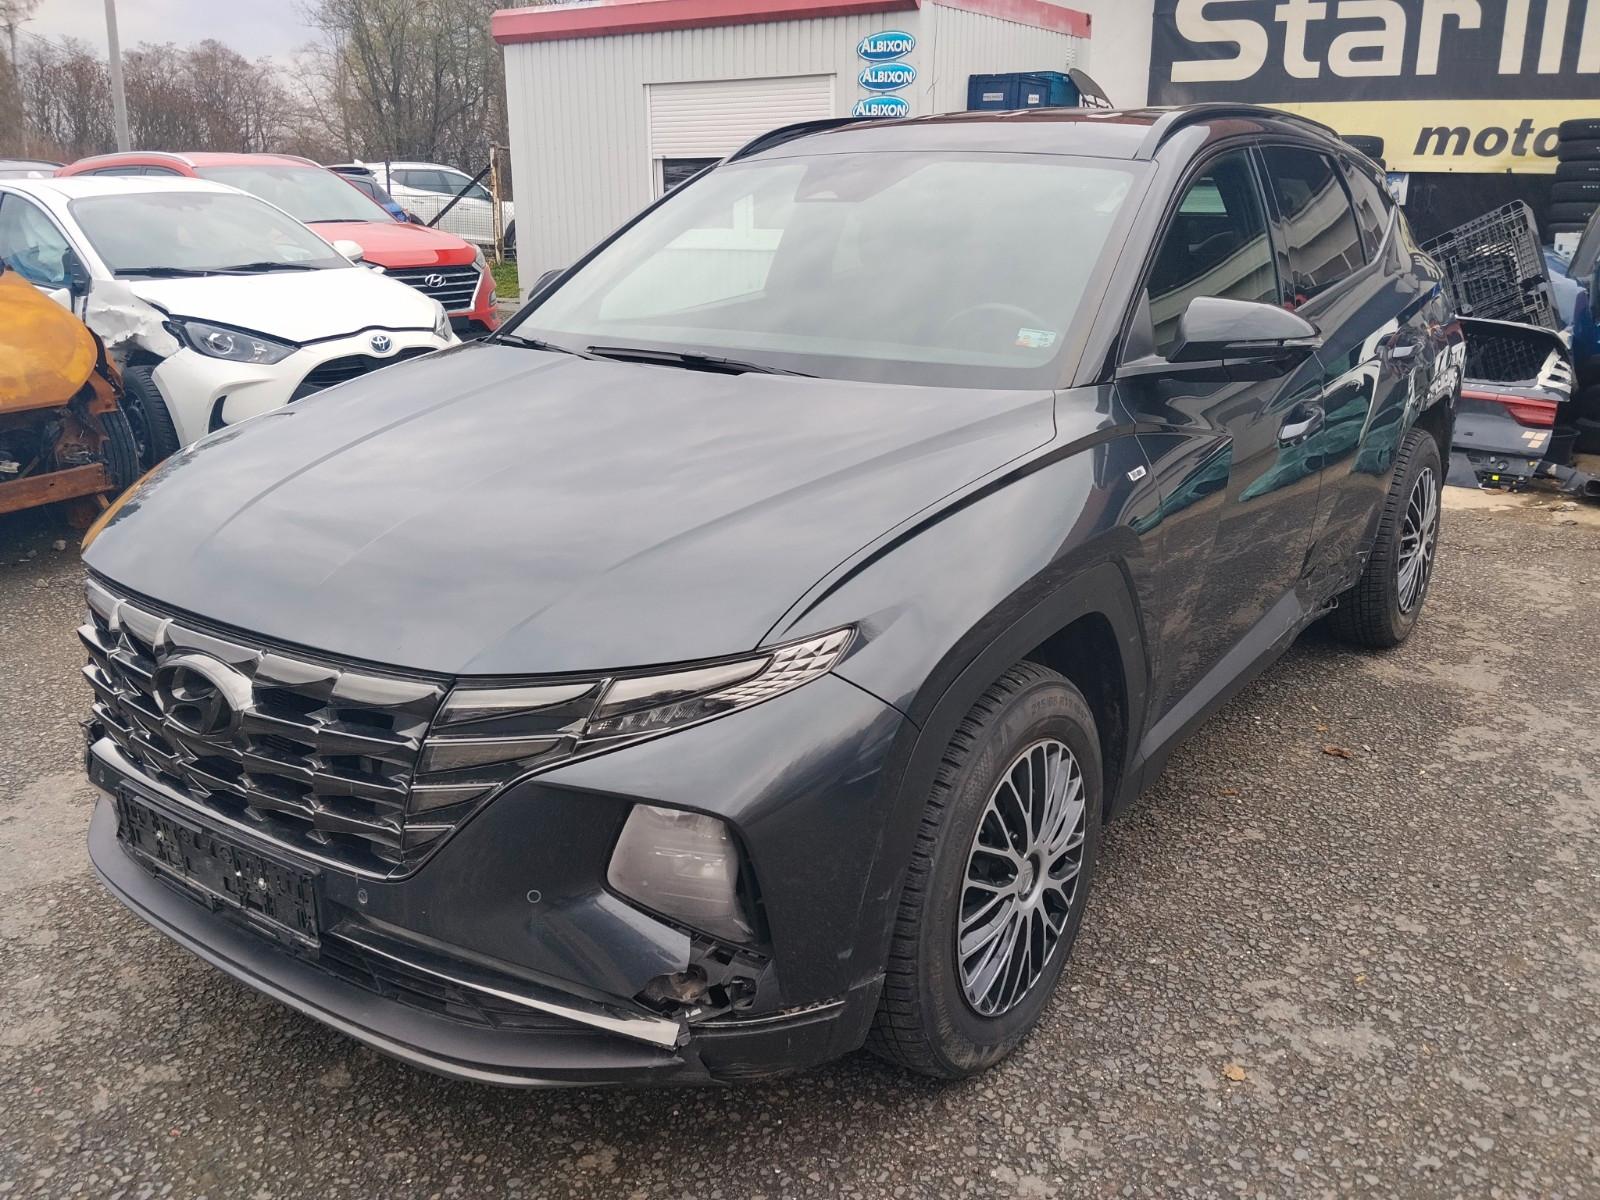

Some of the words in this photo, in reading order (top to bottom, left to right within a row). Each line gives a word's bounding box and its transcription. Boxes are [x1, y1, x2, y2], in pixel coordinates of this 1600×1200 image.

[861, 38, 912, 53] ALBIXON
[862, 67, 913, 83] ALBIXON
[855, 100, 906, 116] ALBIXON
